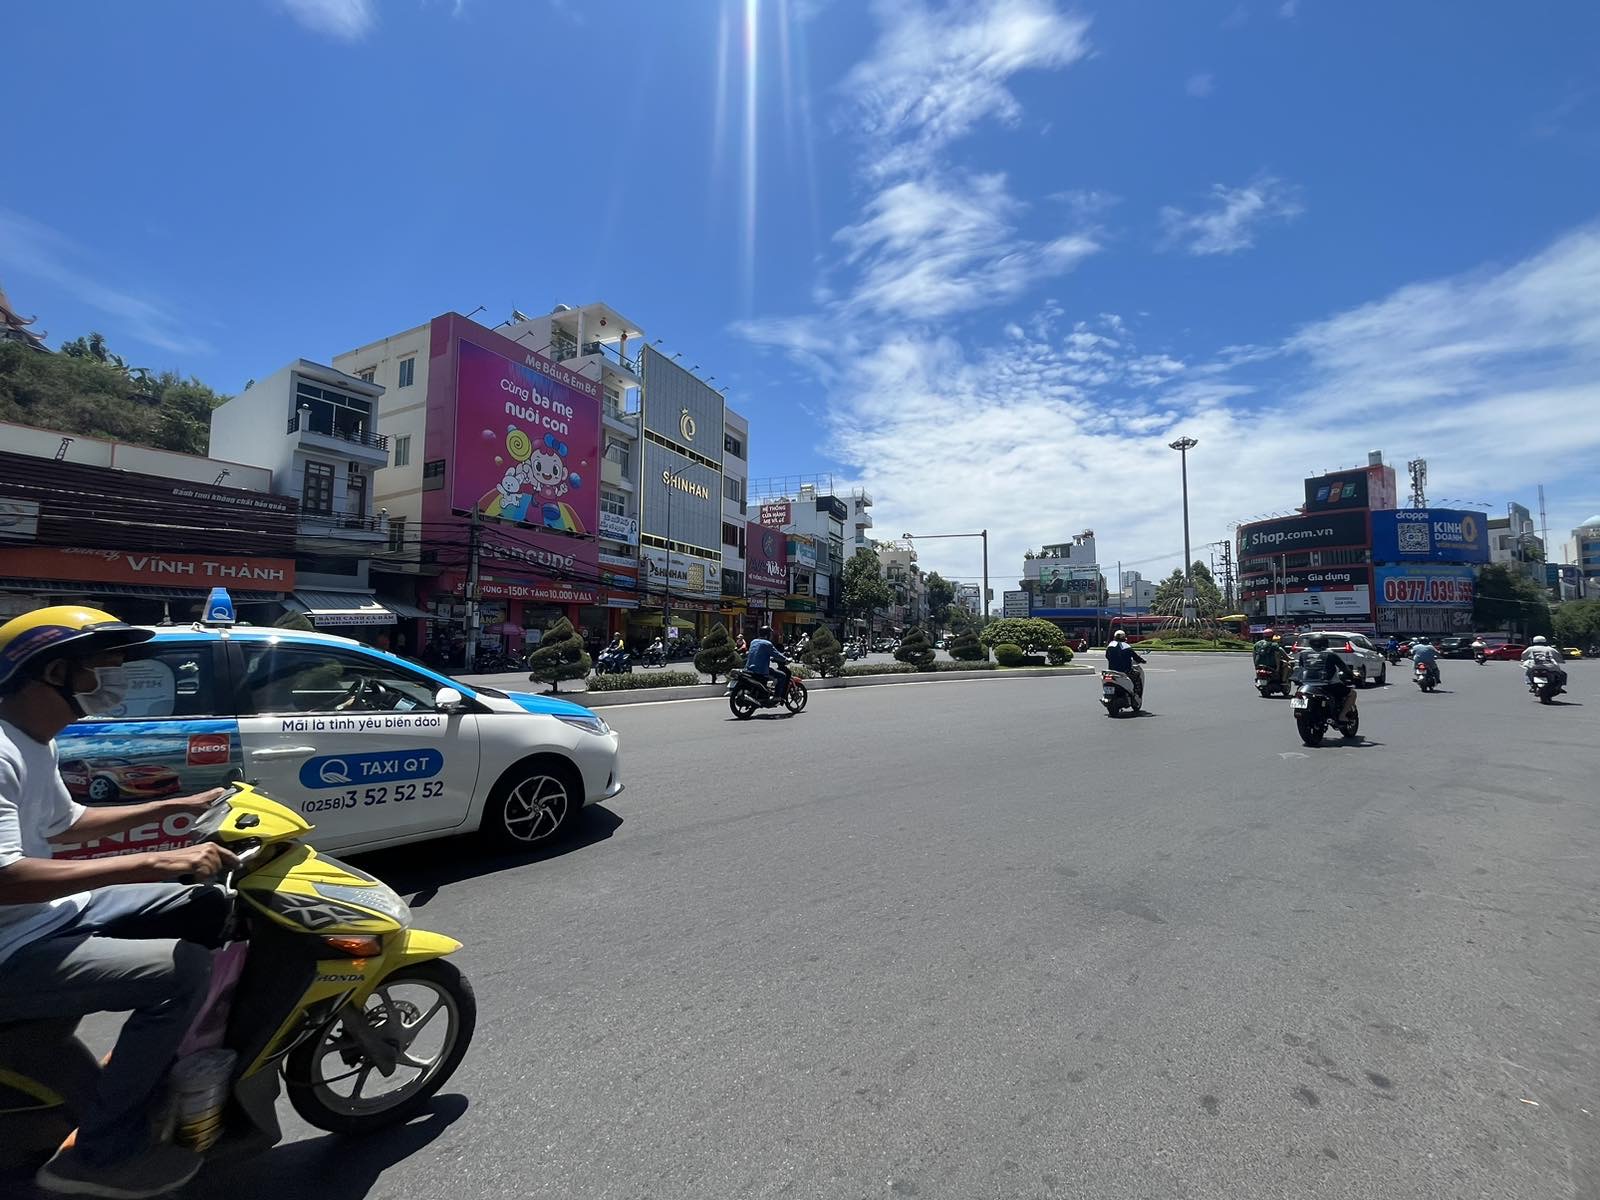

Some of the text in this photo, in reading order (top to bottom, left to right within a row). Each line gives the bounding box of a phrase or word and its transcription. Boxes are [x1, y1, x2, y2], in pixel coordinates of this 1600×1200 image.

[525, 354, 597, 396] Mẹ Bầu & Em Bé
[500, 378, 573, 422] Cùng ba mẹ
[505, 401, 568, 435] nuôi con
[662, 471, 709, 499] SHINHAN
[1434, 522, 1462, 533] KINH
[1252, 528, 1333, 545] Shop.com.vn
[1434, 533, 1463, 541] DOANH
[126, 556, 195, 575] VĨNH
[655, 566, 688, 580] SHINHAN
[1308, 573, 1323, 582] Gia
[1324, 572, 1351, 582] dụng
[282, 716, 441, 732] Mãi là tình yêu biển đảo!
[191, 744, 228, 753] ENEOS
[360, 760, 399, 776] TAXI
[404, 758, 430, 772] QT
[364, 787, 388, 806] 52
[394, 784, 416, 802] 52
[422, 781, 444, 798] 52
[317, 974, 365, 982] HONDA
